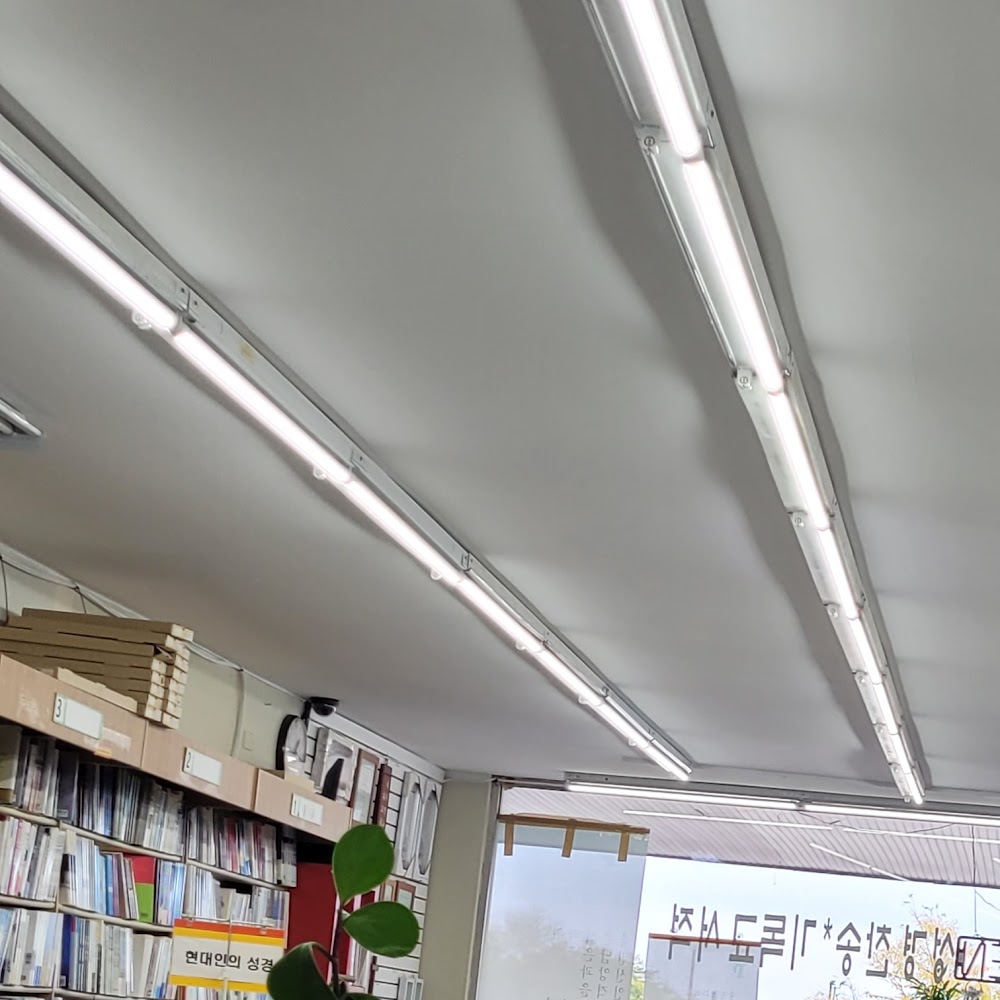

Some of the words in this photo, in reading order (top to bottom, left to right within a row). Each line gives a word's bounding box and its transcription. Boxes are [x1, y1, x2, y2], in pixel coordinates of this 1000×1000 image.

[55, 699, 63, 718] 3
[185, 751, 191, 769] 2
[185, 949, 241, 969] 현대인의
